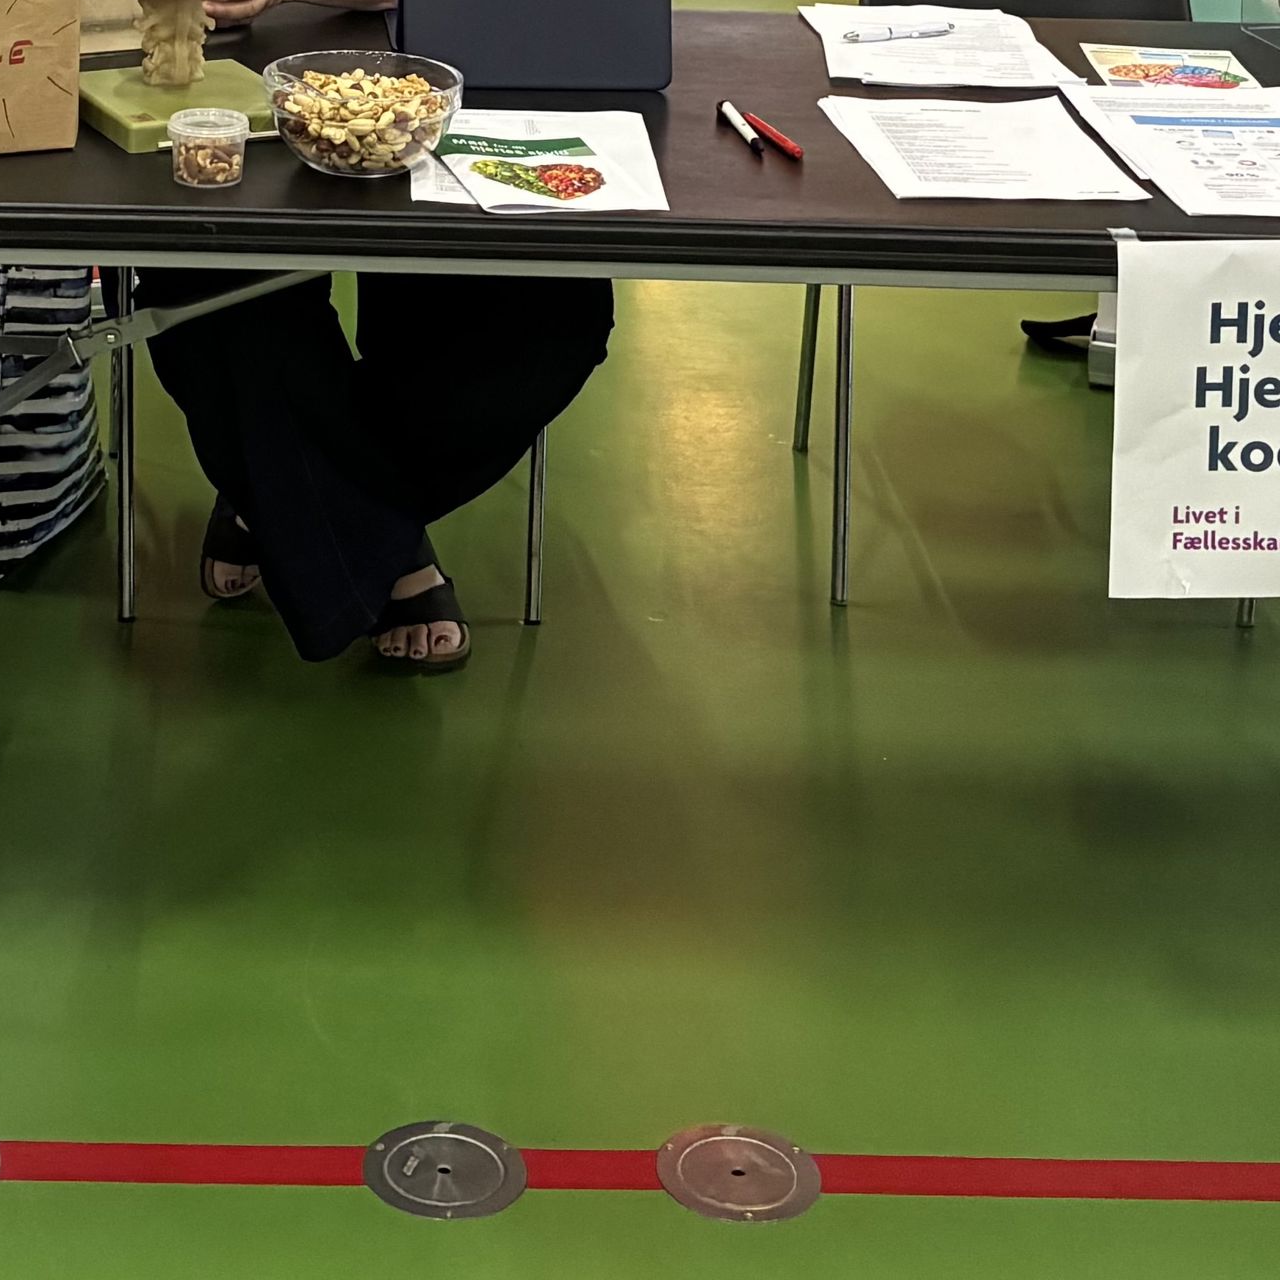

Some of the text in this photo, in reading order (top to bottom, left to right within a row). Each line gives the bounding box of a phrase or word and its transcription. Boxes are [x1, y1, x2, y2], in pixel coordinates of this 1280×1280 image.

[1208, 425, 1280, 472] ko
[1173, 506, 1240, 524] Livet i
[1172, 531, 1280, 551] Fællesska
